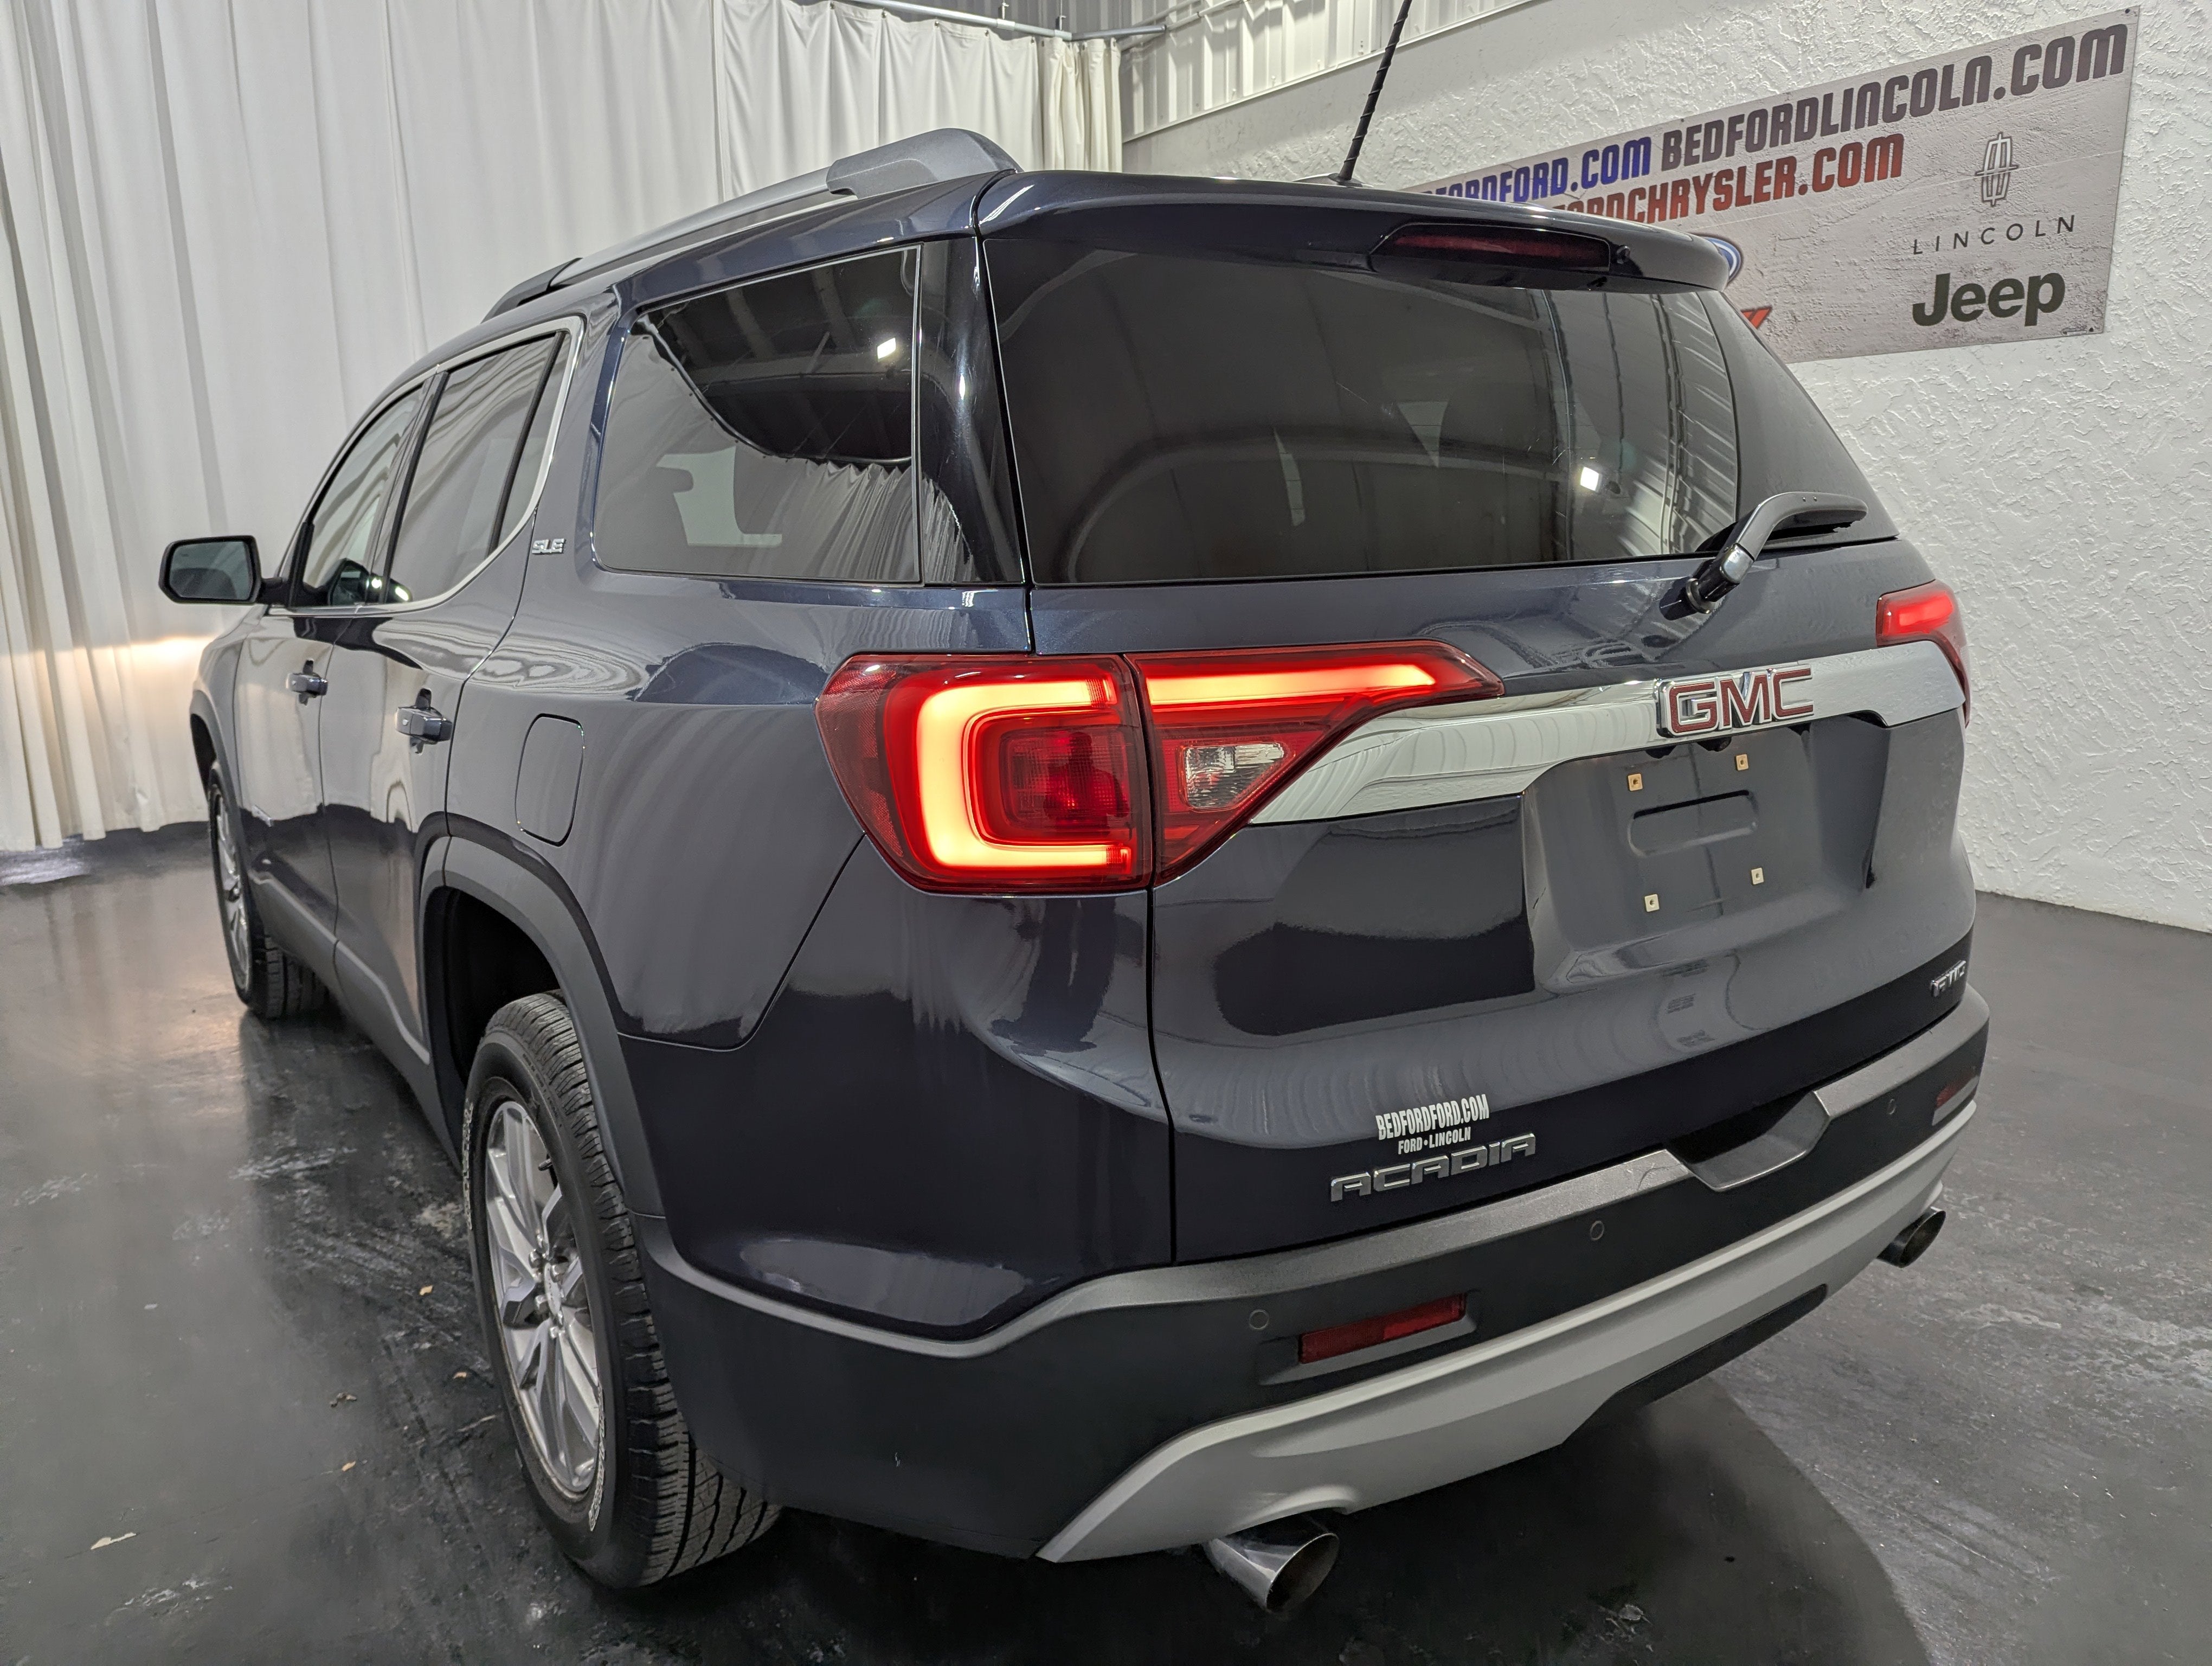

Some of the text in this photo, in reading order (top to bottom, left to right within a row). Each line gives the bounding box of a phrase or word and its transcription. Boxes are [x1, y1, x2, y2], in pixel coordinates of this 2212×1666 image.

[1661, 23, 2128, 172] BEDFORDLINCOLN.COM
[1912, 214, 2075, 255] LINCOLN
[1912, 270, 2066, 327] Jeep
[532, 538, 565, 554] SLE
[1656, 664, 1814, 738] GMC
[1375, 1094, 1489, 1140] BEDFORDFORD.COM
[1398, 1126, 1471, 1155] FORD LINCOLN
[1330, 1132, 1536, 1202] ACADIA
